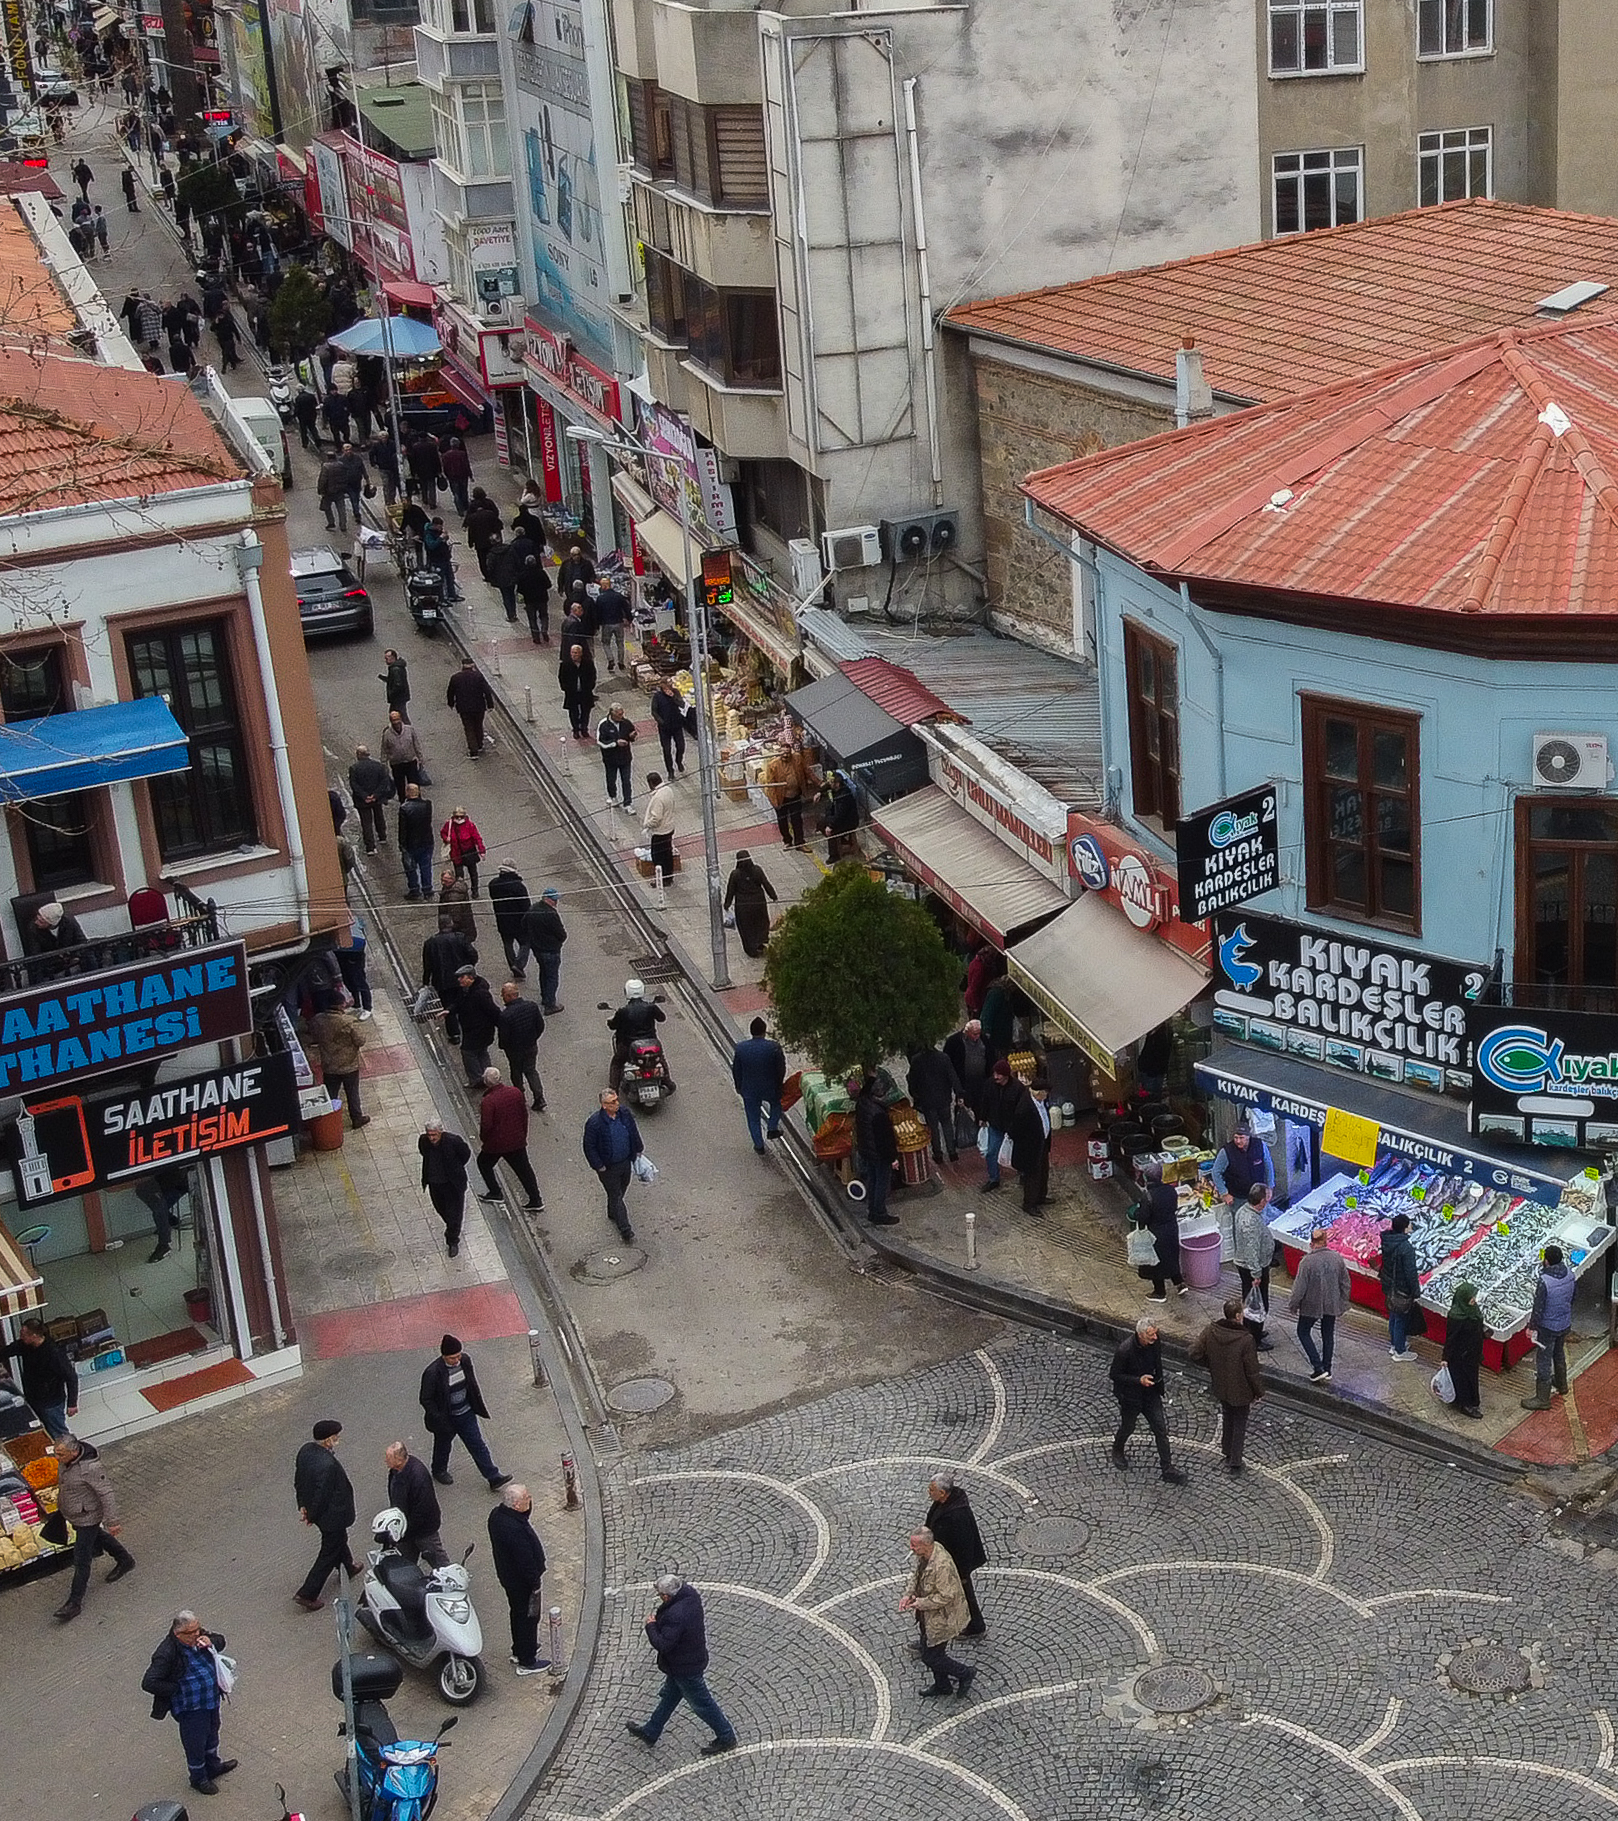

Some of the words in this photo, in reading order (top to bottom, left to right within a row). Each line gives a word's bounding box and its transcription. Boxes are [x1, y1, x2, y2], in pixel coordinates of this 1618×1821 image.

[547, 243, 570, 271] SONY
[1262, 796, 1275, 823] 2
[1195, 852, 1275, 899] KARDEŞLER
[1205, 836, 1263, 876] KIYAK
[1110, 865, 1161, 917] NAMLI
[1198, 872, 1273, 916] BALIKÇILIK
[1299, 934, 1431, 996] KIYAK
[1464, 972, 1485, 1000] 2
[1268, 960, 1466, 1035] KARDEŞLER
[1274, 992, 1461, 1065] BALIKÇILIK
[104, 1067, 262, 1135] SAATHANE
[1217, 1079, 1260, 1103] KIYAK
[1271, 1096, 1326, 1127] KARDEŞ
[1463, 1160, 1474, 1174] 2
[128, 1105, 251, 1167] İLETİŞİM
